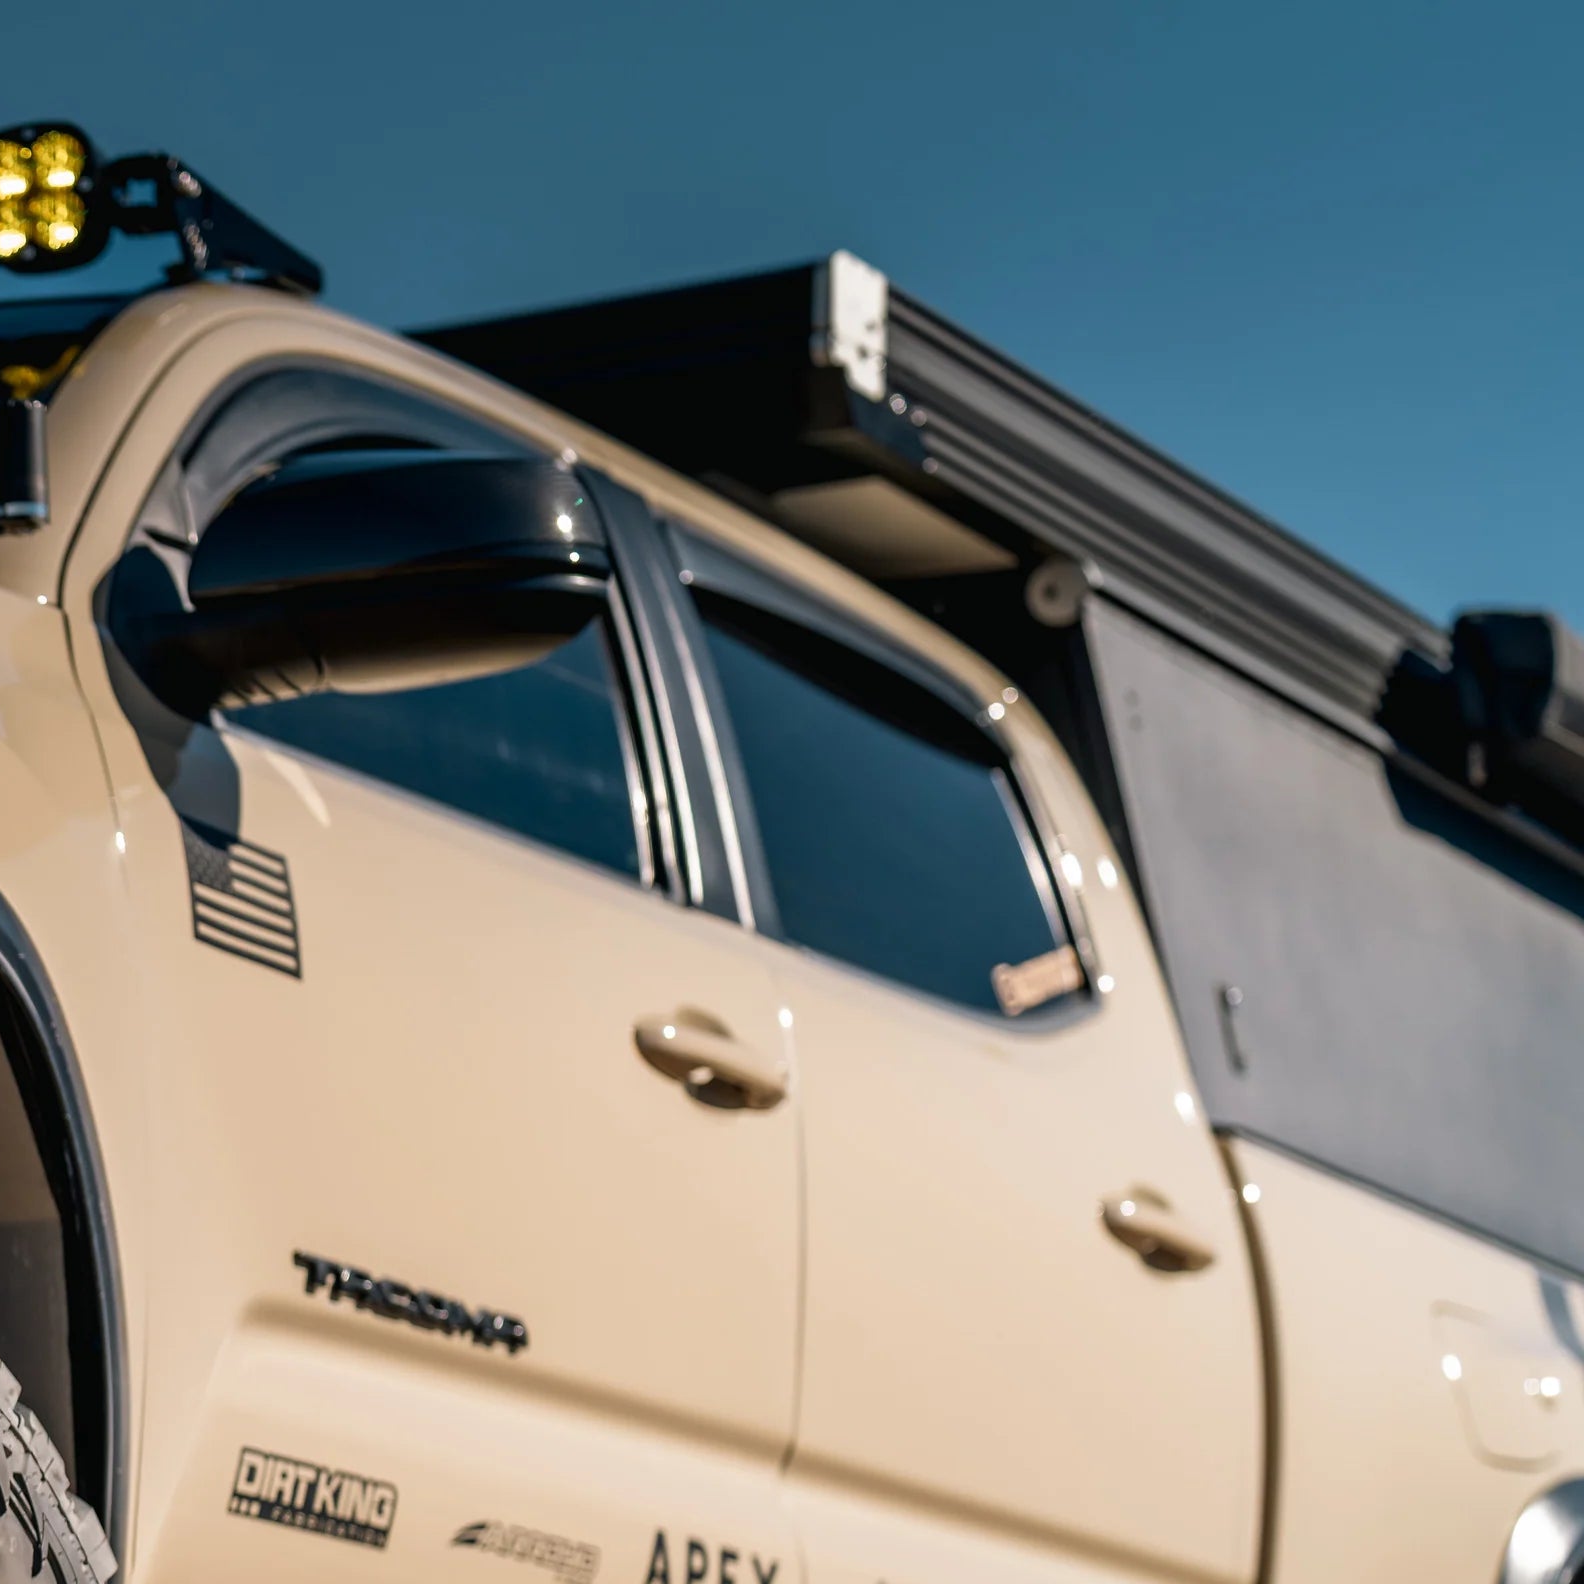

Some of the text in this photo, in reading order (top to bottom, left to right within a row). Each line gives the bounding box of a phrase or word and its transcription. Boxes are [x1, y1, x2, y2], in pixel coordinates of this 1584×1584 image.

[292, 1249, 528, 1356] TACOMA
[234, 1450, 317, 1510] DIRT
[312, 1471, 396, 1530] KING
